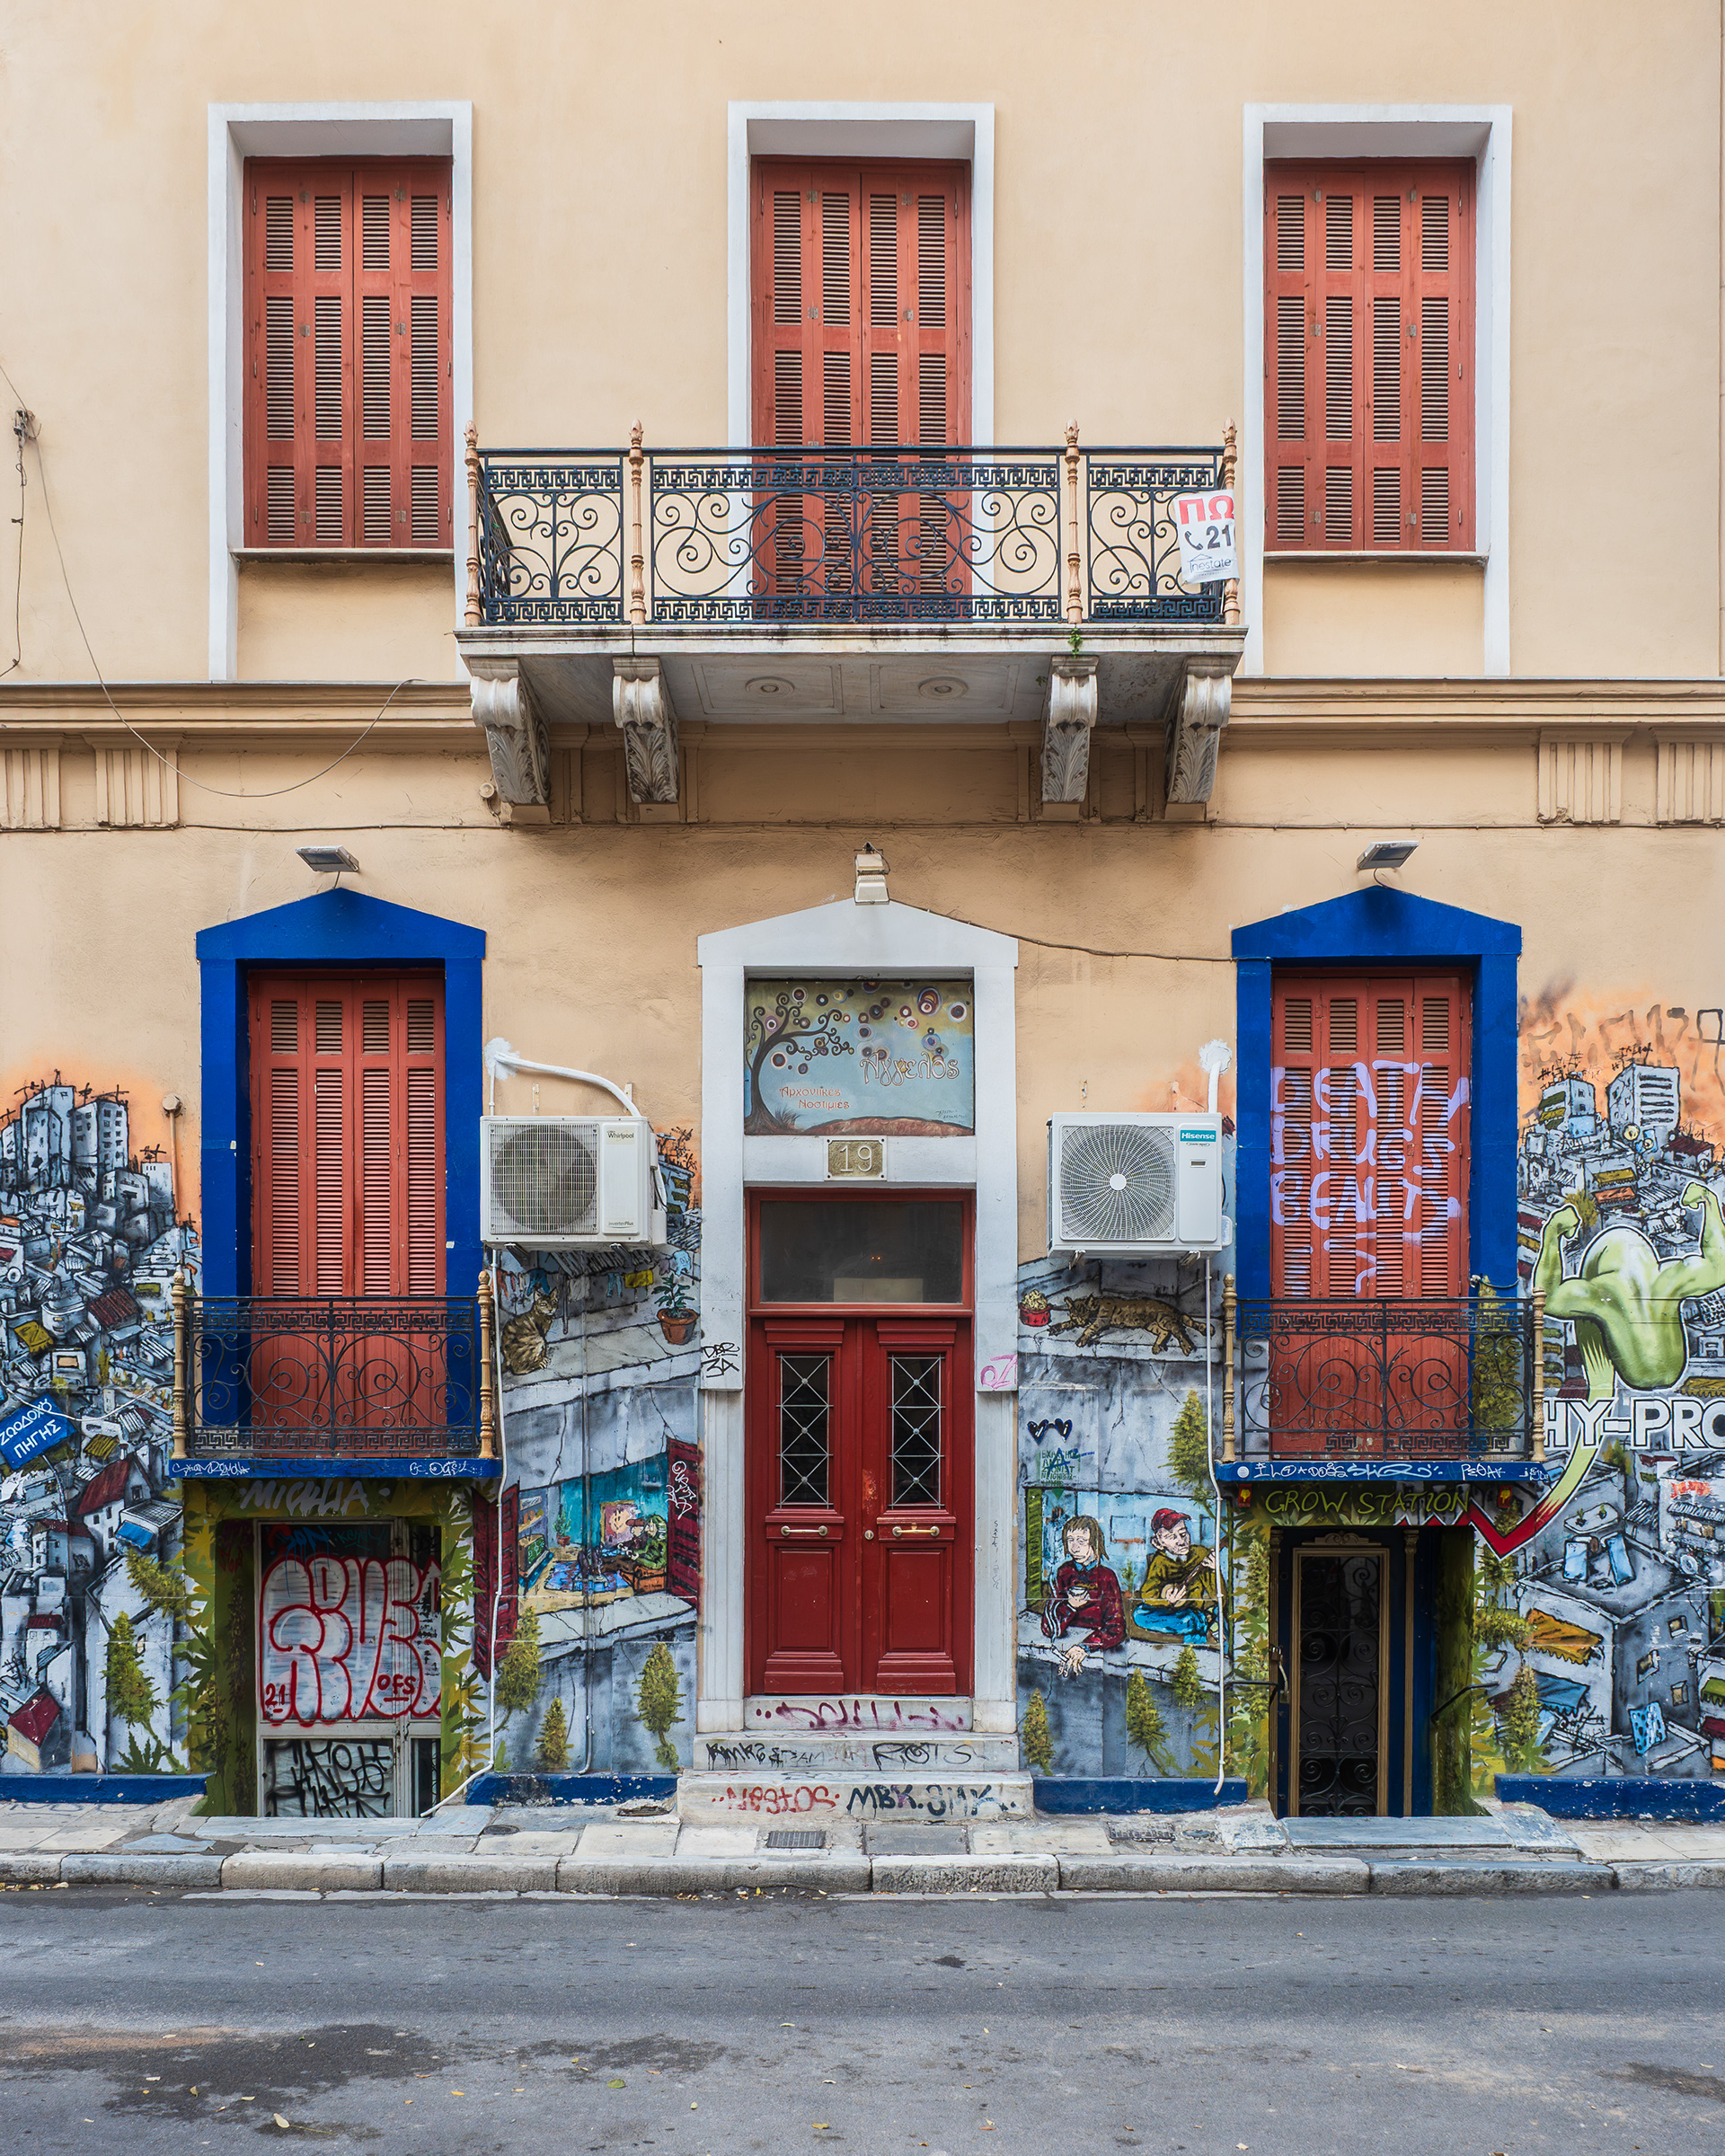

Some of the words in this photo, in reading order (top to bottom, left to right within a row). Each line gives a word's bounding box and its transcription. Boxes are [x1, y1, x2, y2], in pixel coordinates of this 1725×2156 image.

[1206, 524, 1232, 550] 21
[606, 1131, 634, 1140] Whirlpool
[1181, 1132, 1216, 1140] Hisense
[839, 1145, 874, 1173] 19
[13, 1418, 61, 1459] ΠΗΓΗΣ
[1265, 1490, 1348, 1514] GROW
[1358, 1491, 1470, 1515] STATION
